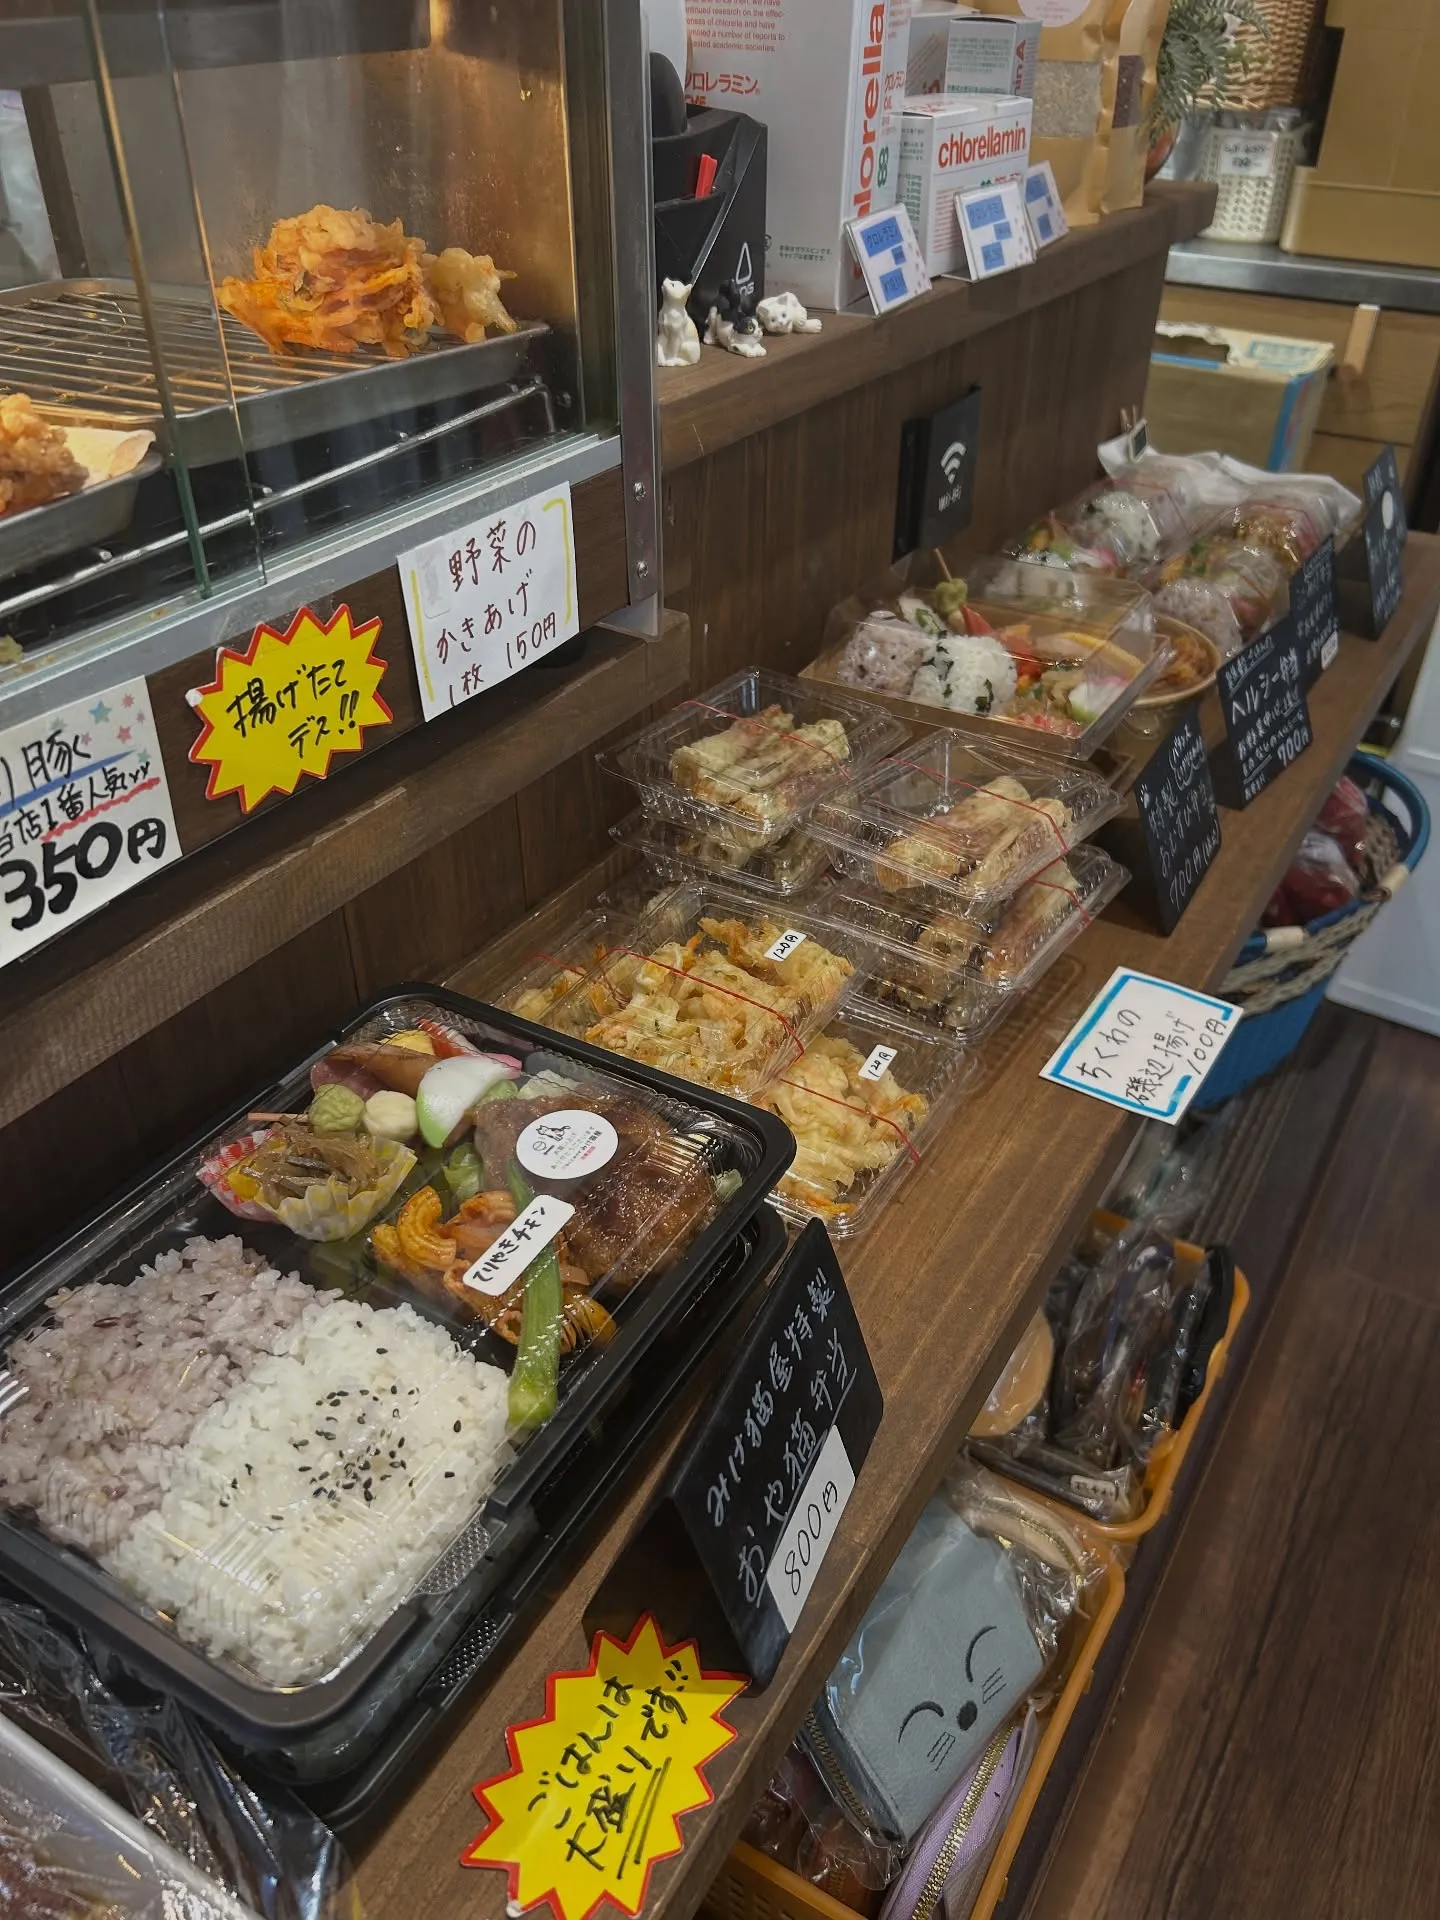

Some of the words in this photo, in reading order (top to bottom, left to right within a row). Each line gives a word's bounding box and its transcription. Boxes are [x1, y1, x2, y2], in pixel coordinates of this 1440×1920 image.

[853, 3, 885, 218] lorella
[937, 120, 1026, 169] chlorellamin
[448, 520, 537, 593] 野菜の
[436, 568, 533, 665] かきあげ
[505, 611, 556, 669] 150円
[0, 817, 167, 931] 350円
[1075, 1008, 1142, 1079] ちくわの
[1186, 1017, 1227, 1076] 100円
[783, 1479, 839, 1596] 800円
